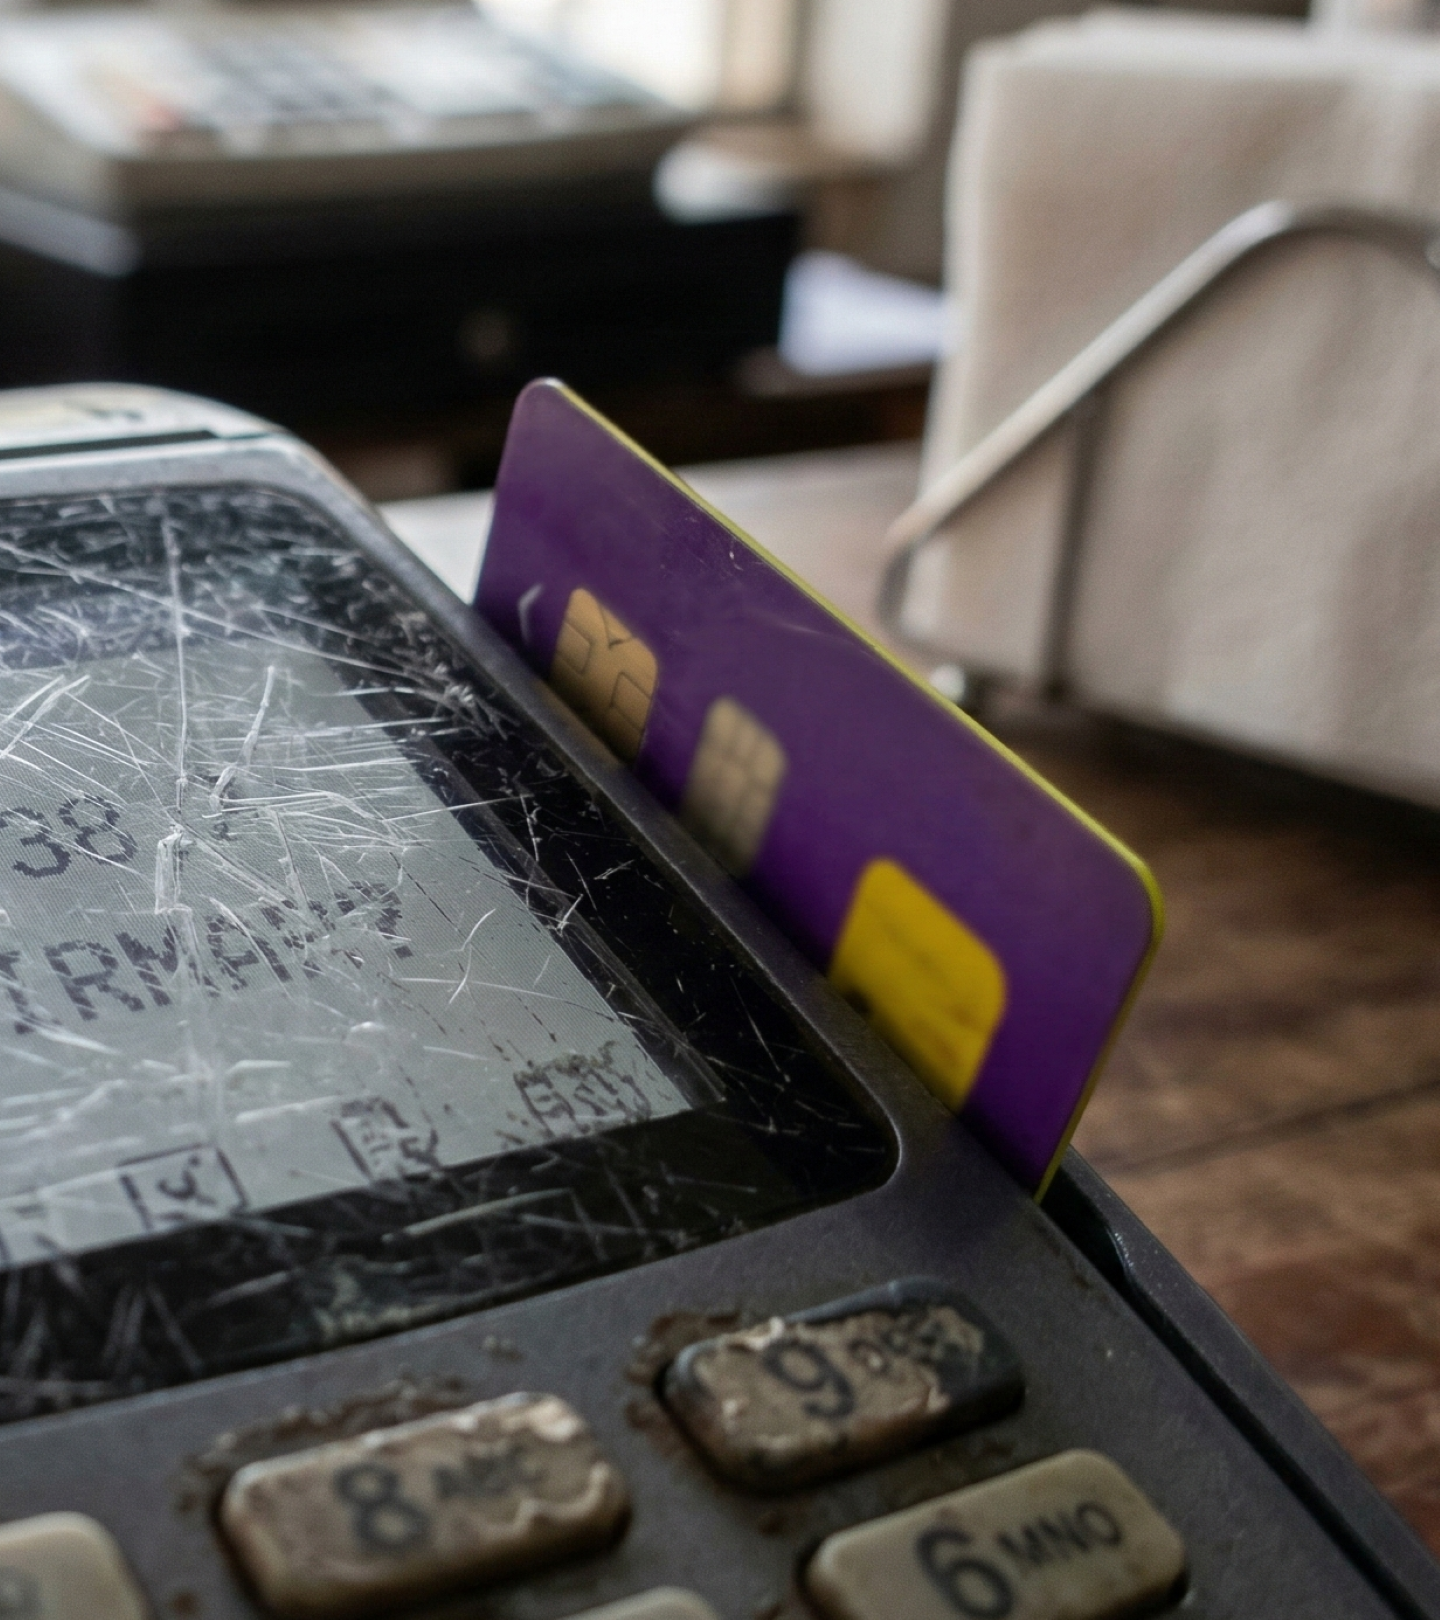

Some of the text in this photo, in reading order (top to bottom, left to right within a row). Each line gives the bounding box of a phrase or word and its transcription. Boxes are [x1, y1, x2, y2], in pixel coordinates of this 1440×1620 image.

[762, 1337, 856, 1420] 9
[333, 1463, 431, 1556] 8
[914, 1502, 1123, 1619] 6 MNO
